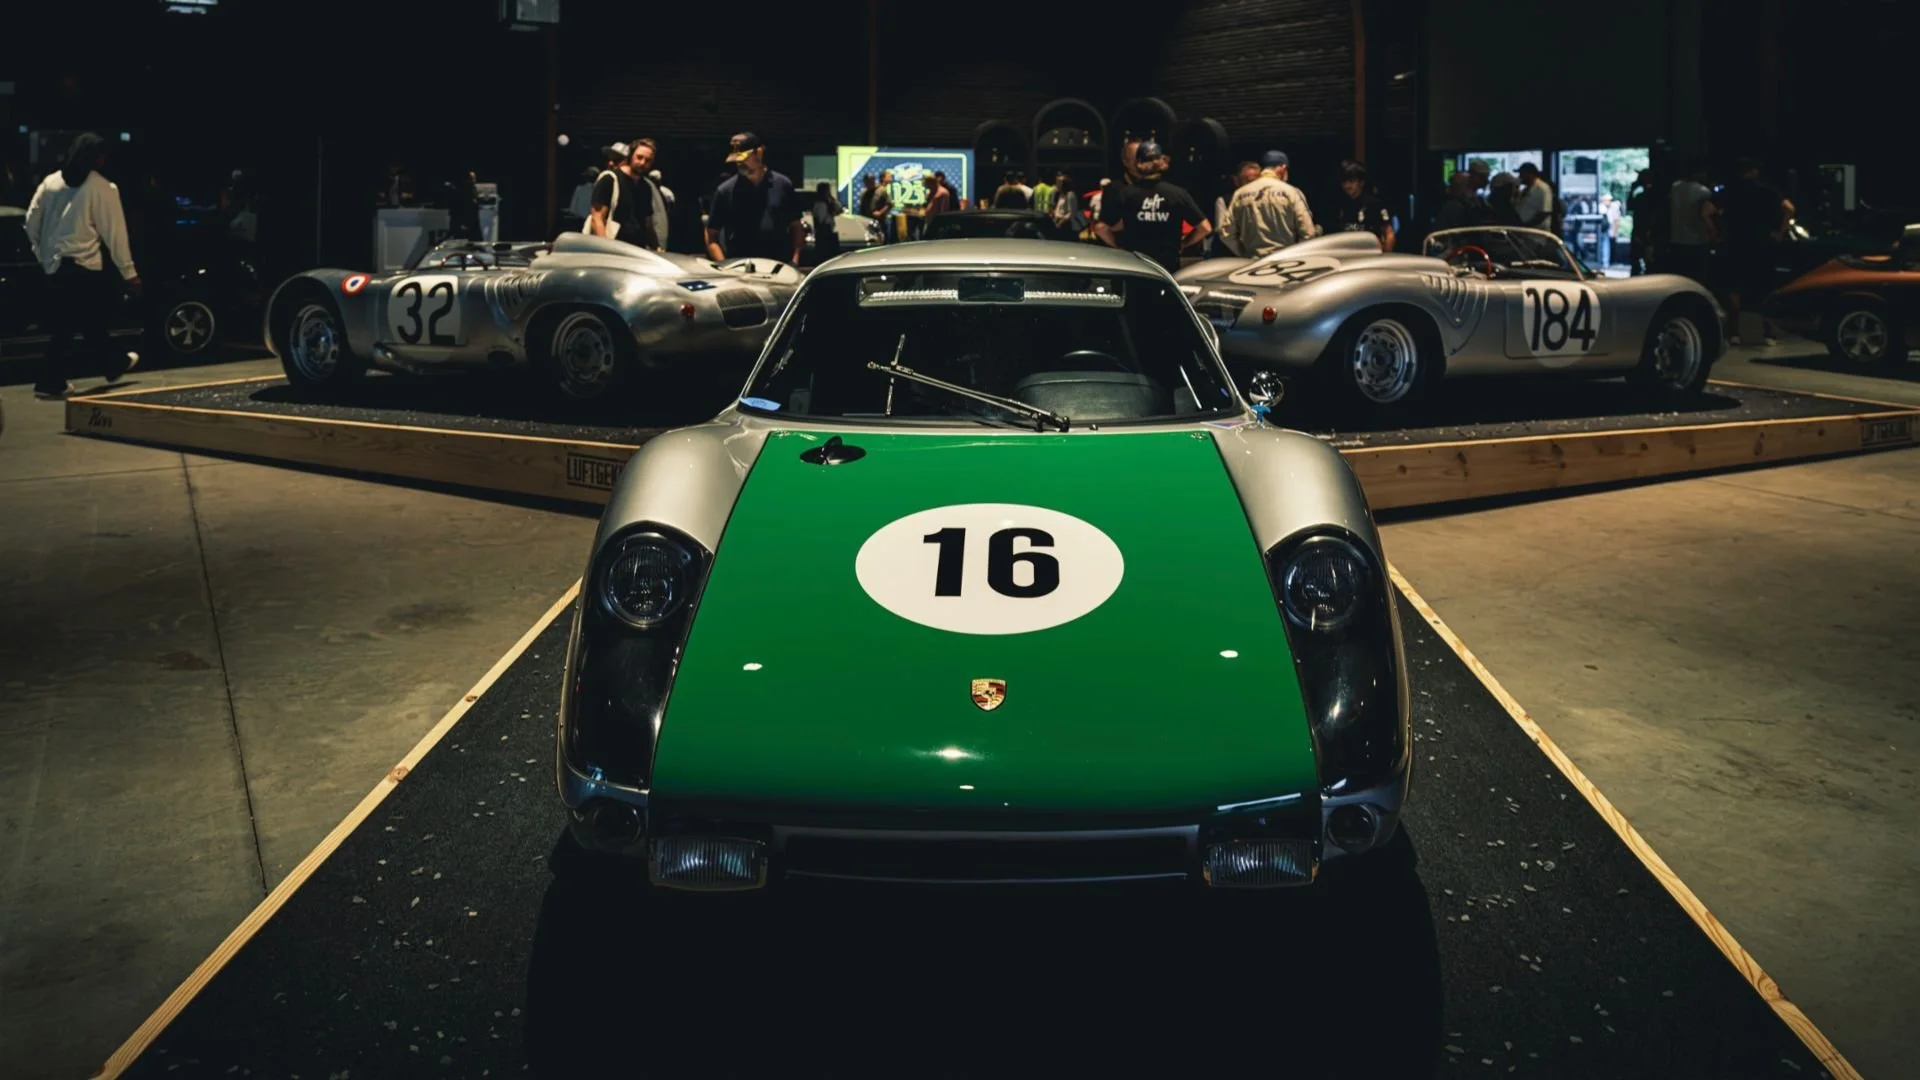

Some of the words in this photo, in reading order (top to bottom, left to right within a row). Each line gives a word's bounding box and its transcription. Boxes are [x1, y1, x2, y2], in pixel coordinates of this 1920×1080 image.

[1137, 210, 1170, 222] CREW
[1236, 260, 1334, 284] 184
[396, 281, 456, 345] 32
[1525, 288, 1596, 351] 184
[923, 527, 1060, 599] 16
